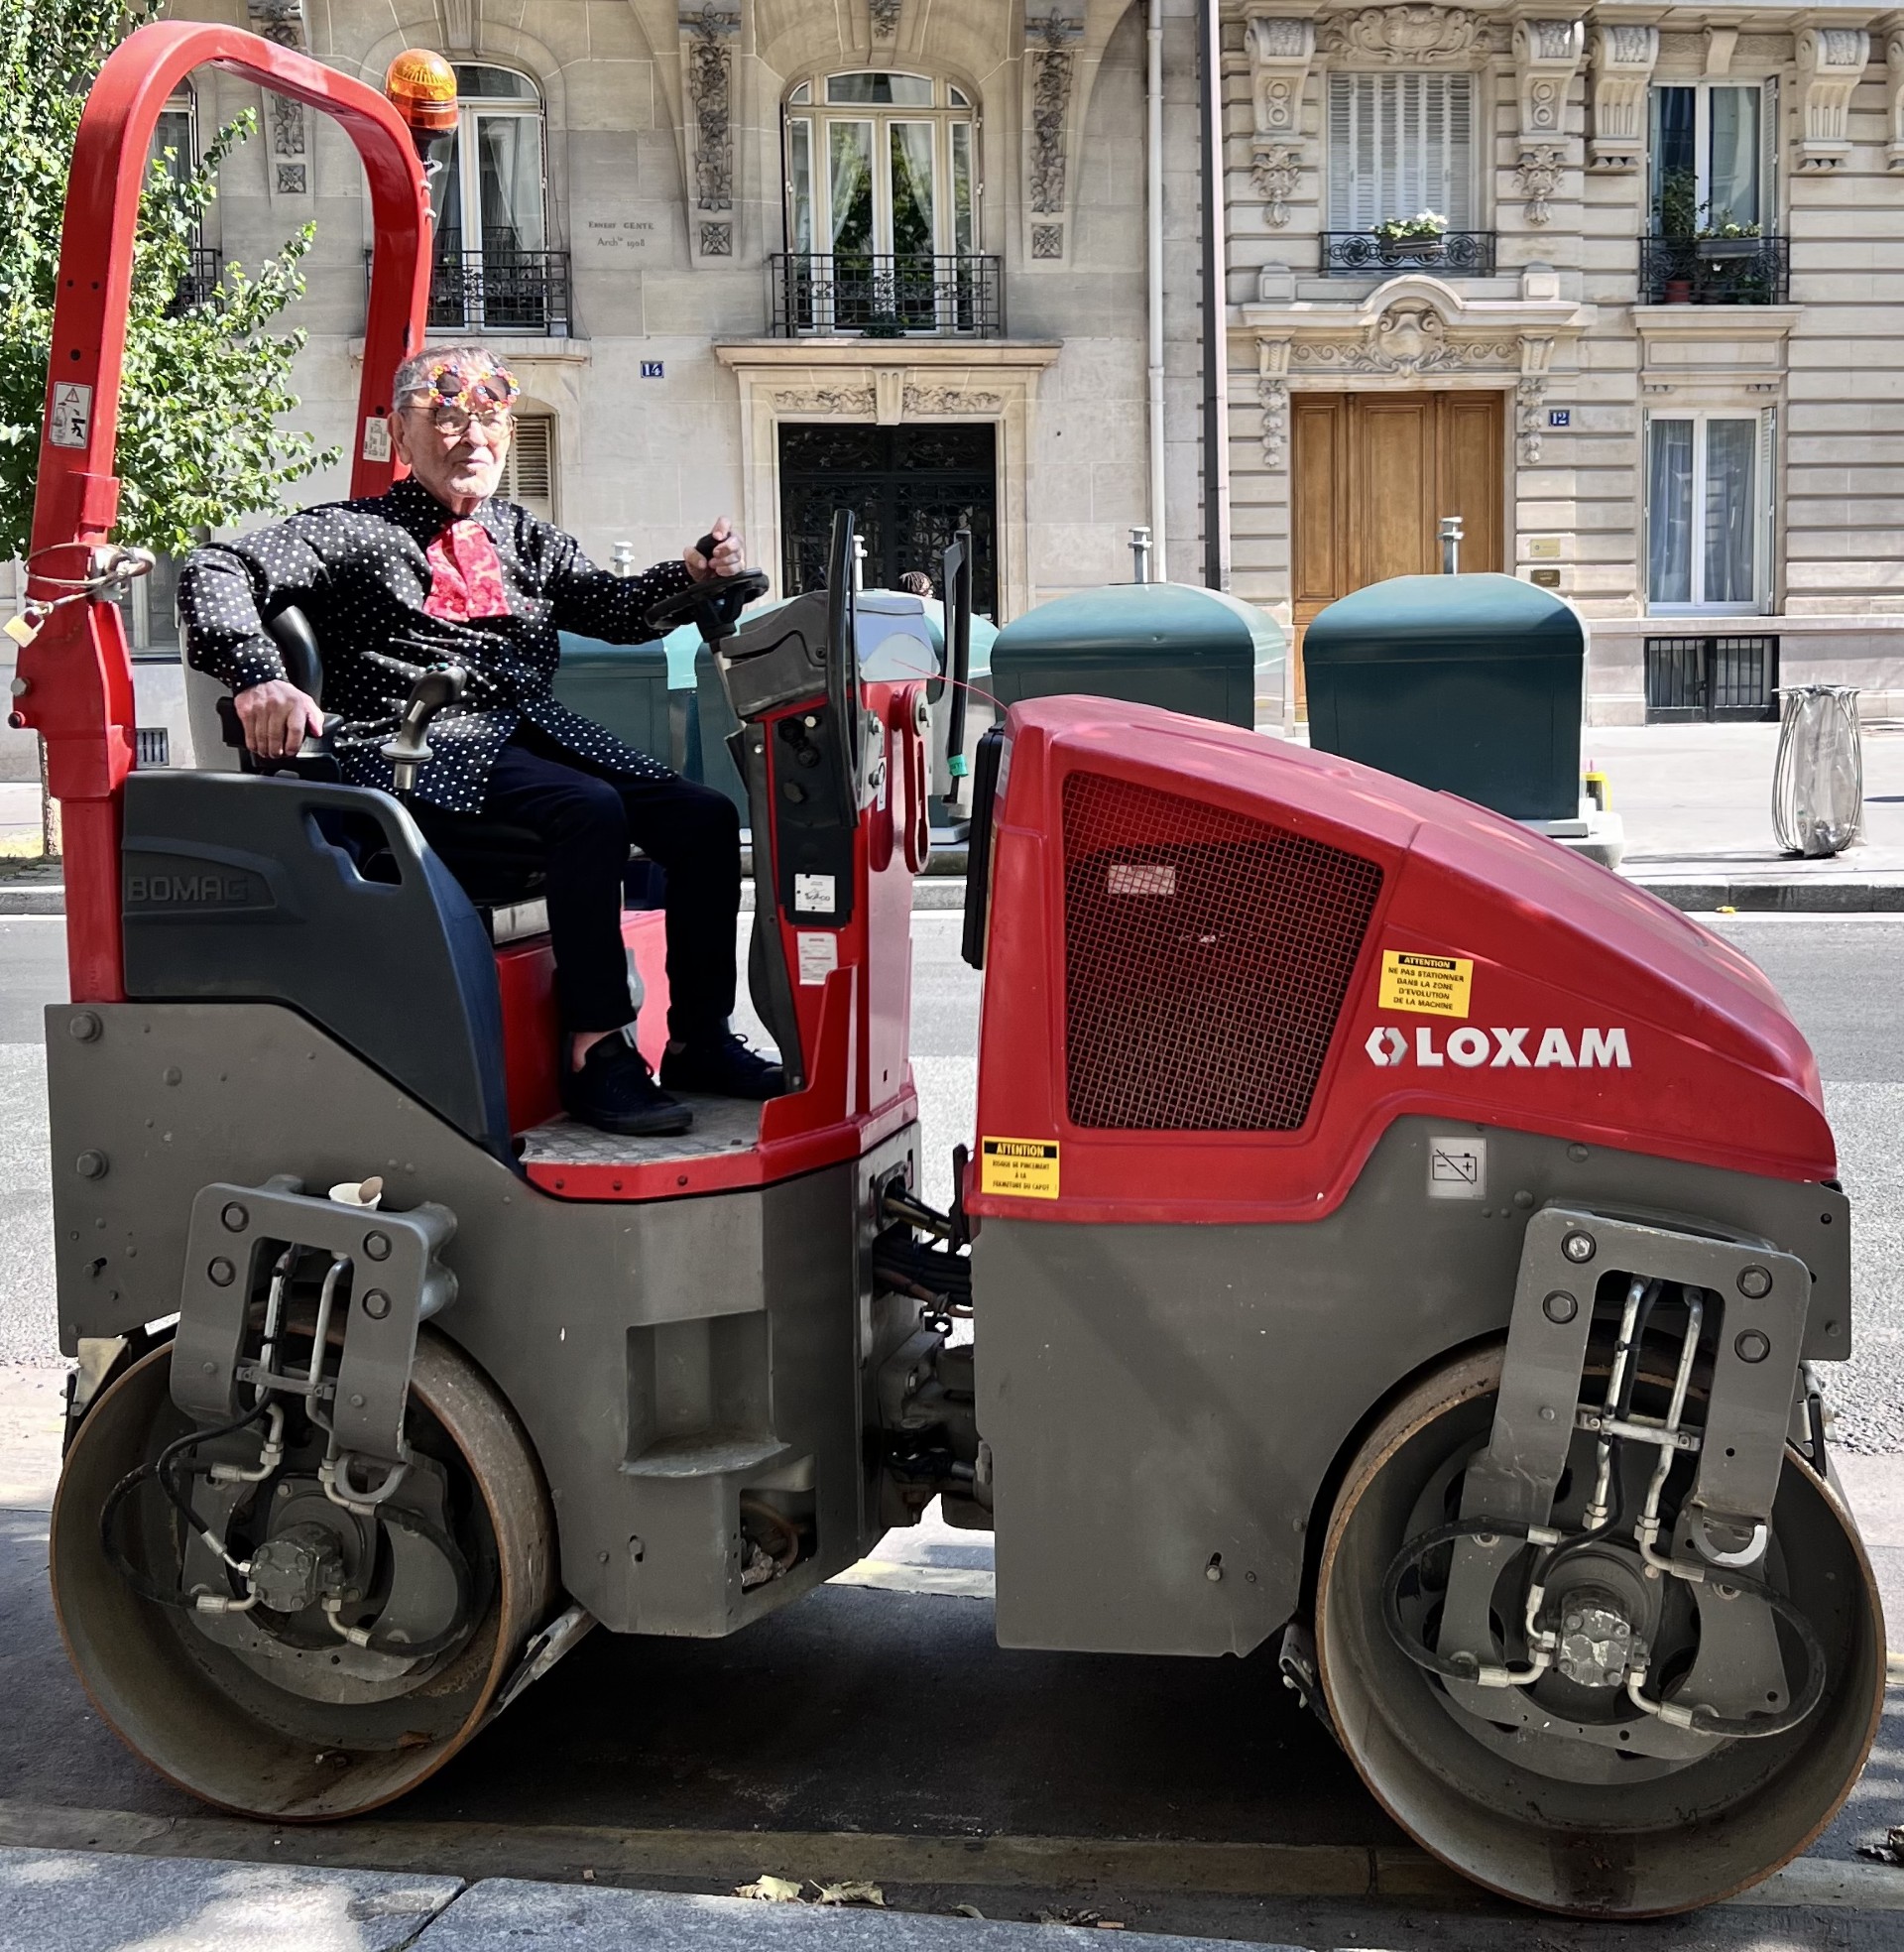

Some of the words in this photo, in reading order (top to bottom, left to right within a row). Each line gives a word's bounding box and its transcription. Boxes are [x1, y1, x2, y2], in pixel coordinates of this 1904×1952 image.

[627, 238, 646, 250] 1908
[645, 363, 661, 376] 14
[1552, 412, 1567, 425] 12
[127, 876, 248, 902] BOMAG
[1403, 956, 1451, 969] ATTENTION
[1388, 966, 1398, 975] NE
[1400, 968, 1415, 977] PAS
[1417, 970, 1465, 983] STATIONNER
[1396, 977, 1418, 987] DANS
[1432, 981, 1454, 991] ZONE
[1393, 996, 1403, 1005] DE
[1417, 1000, 1454, 1011] MACHINE
[1415, 1027, 1632, 1068] LOXAM
[996, 1142, 1045, 1158] ATTENTION
